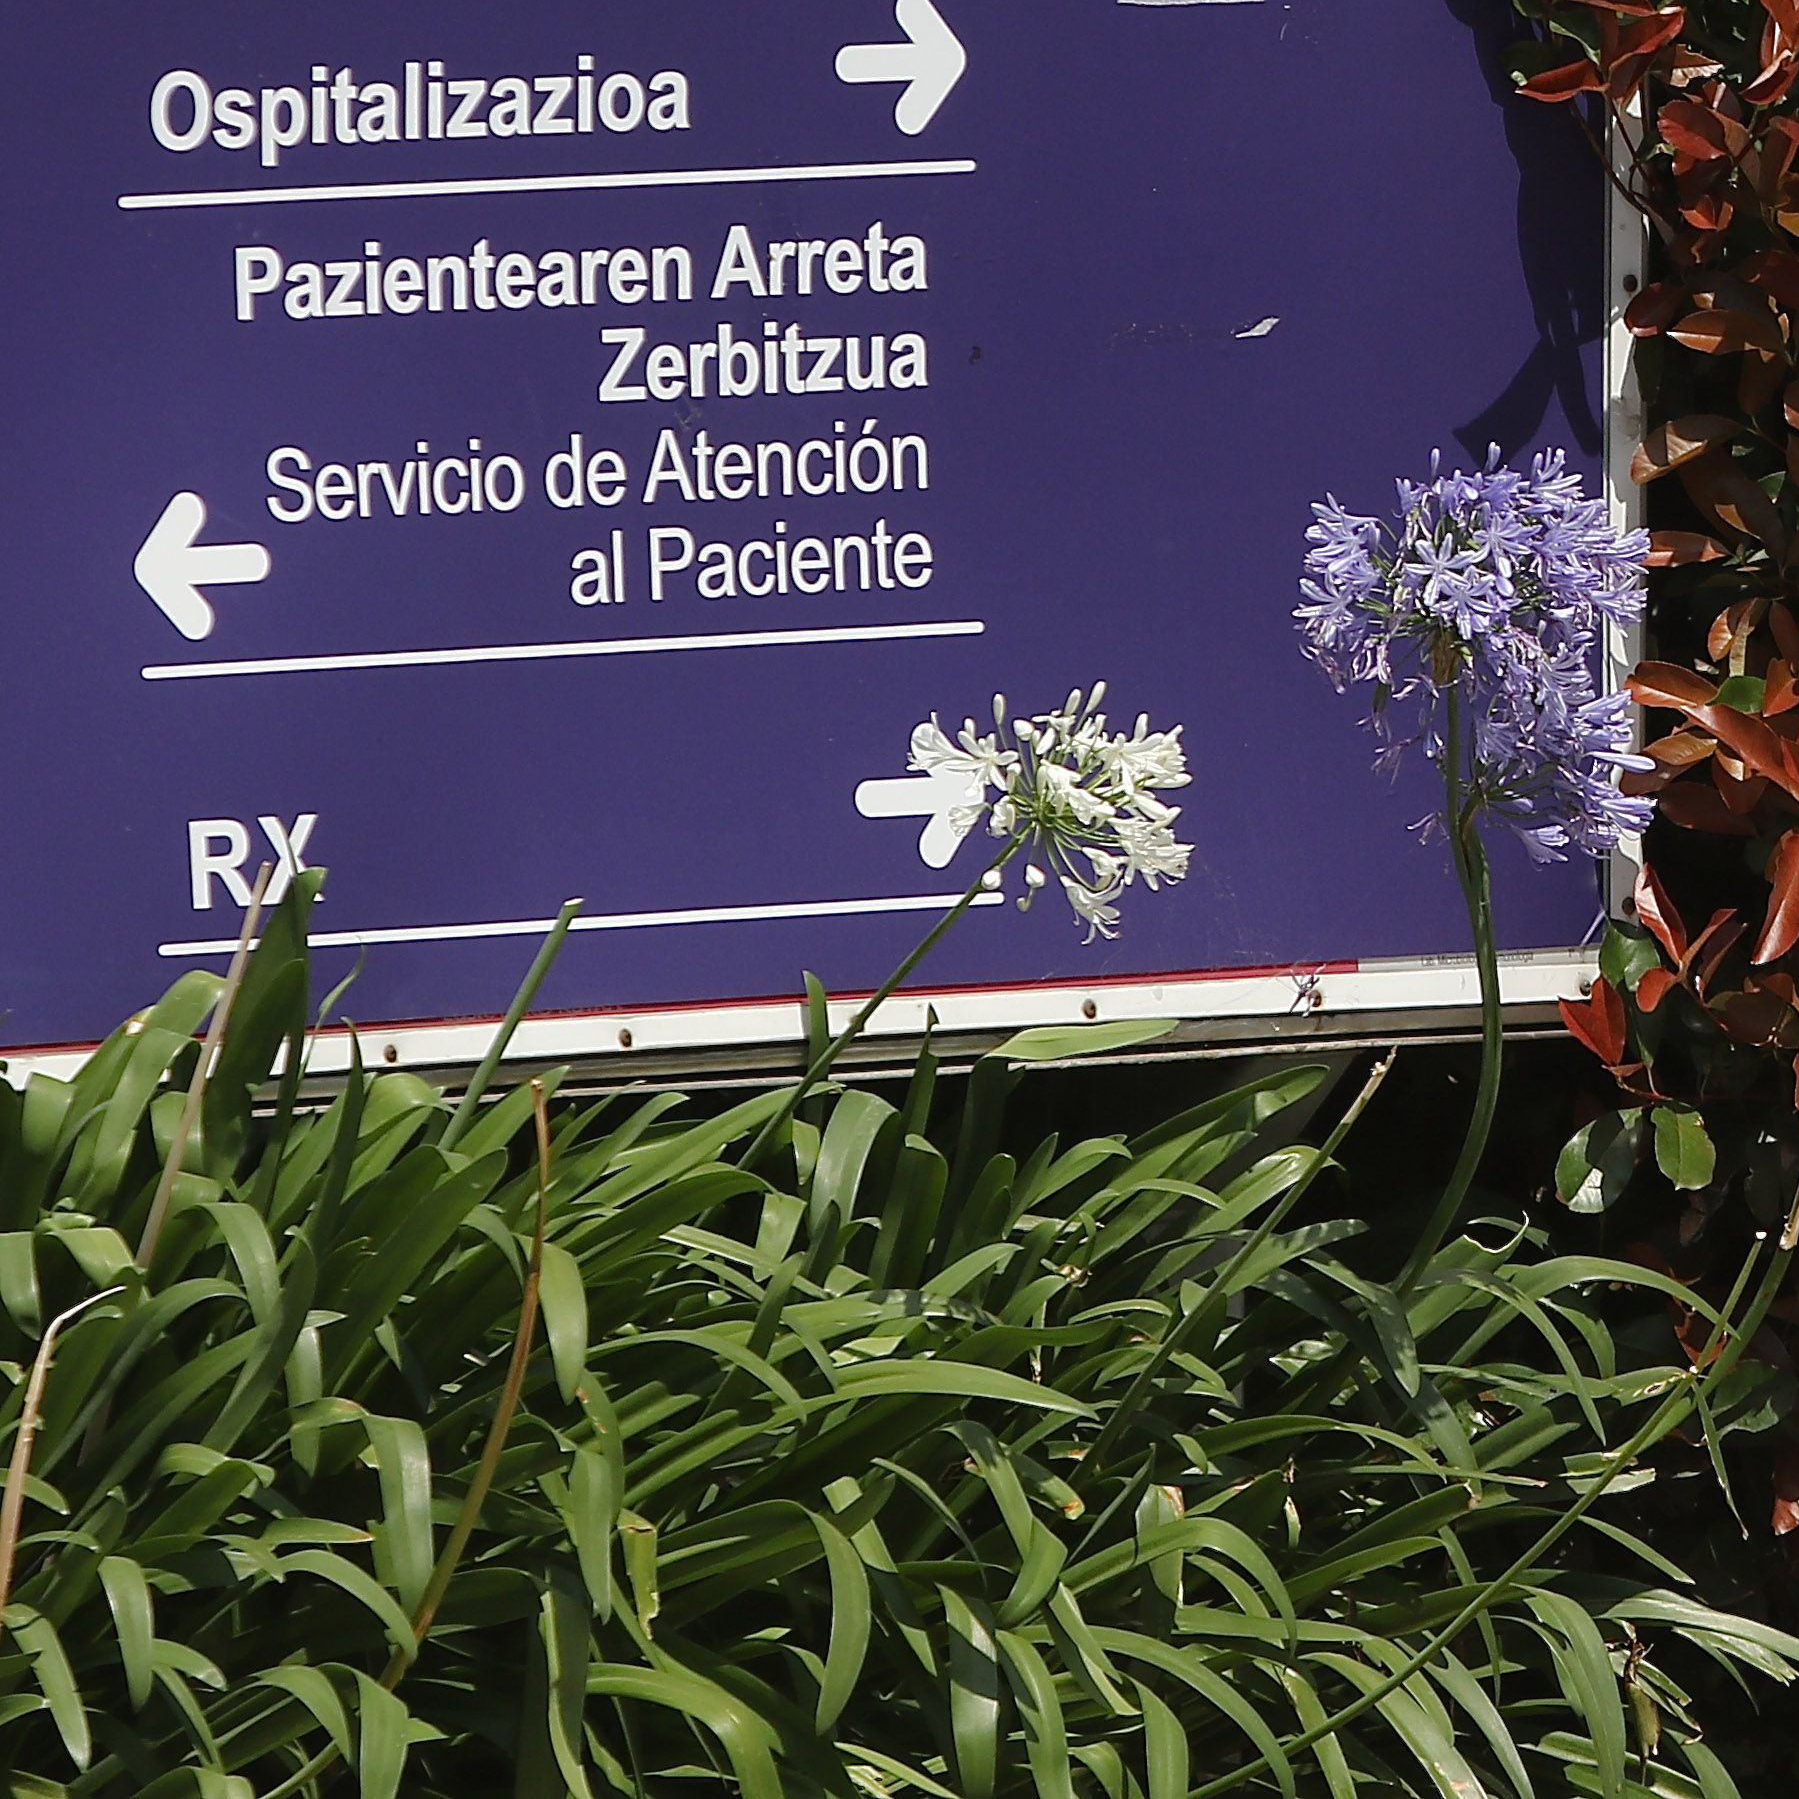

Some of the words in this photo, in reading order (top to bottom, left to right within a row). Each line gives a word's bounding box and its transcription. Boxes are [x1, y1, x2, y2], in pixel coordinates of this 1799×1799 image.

[150, 55, 691, 167] Ospitalizazioa
[234, 230, 693, 323] Pazientearen
[711, 221, 928, 301] Arreta
[599, 322, 928, 403] Zerbitzua
[266, 436, 526, 523] Servicio
[546, 434, 627, 508] de
[644, 419, 930, 507] Atención
[570, 531, 626, 608] al
[647, 519, 934, 602] Paciente
[188, 812, 324, 910] RX
